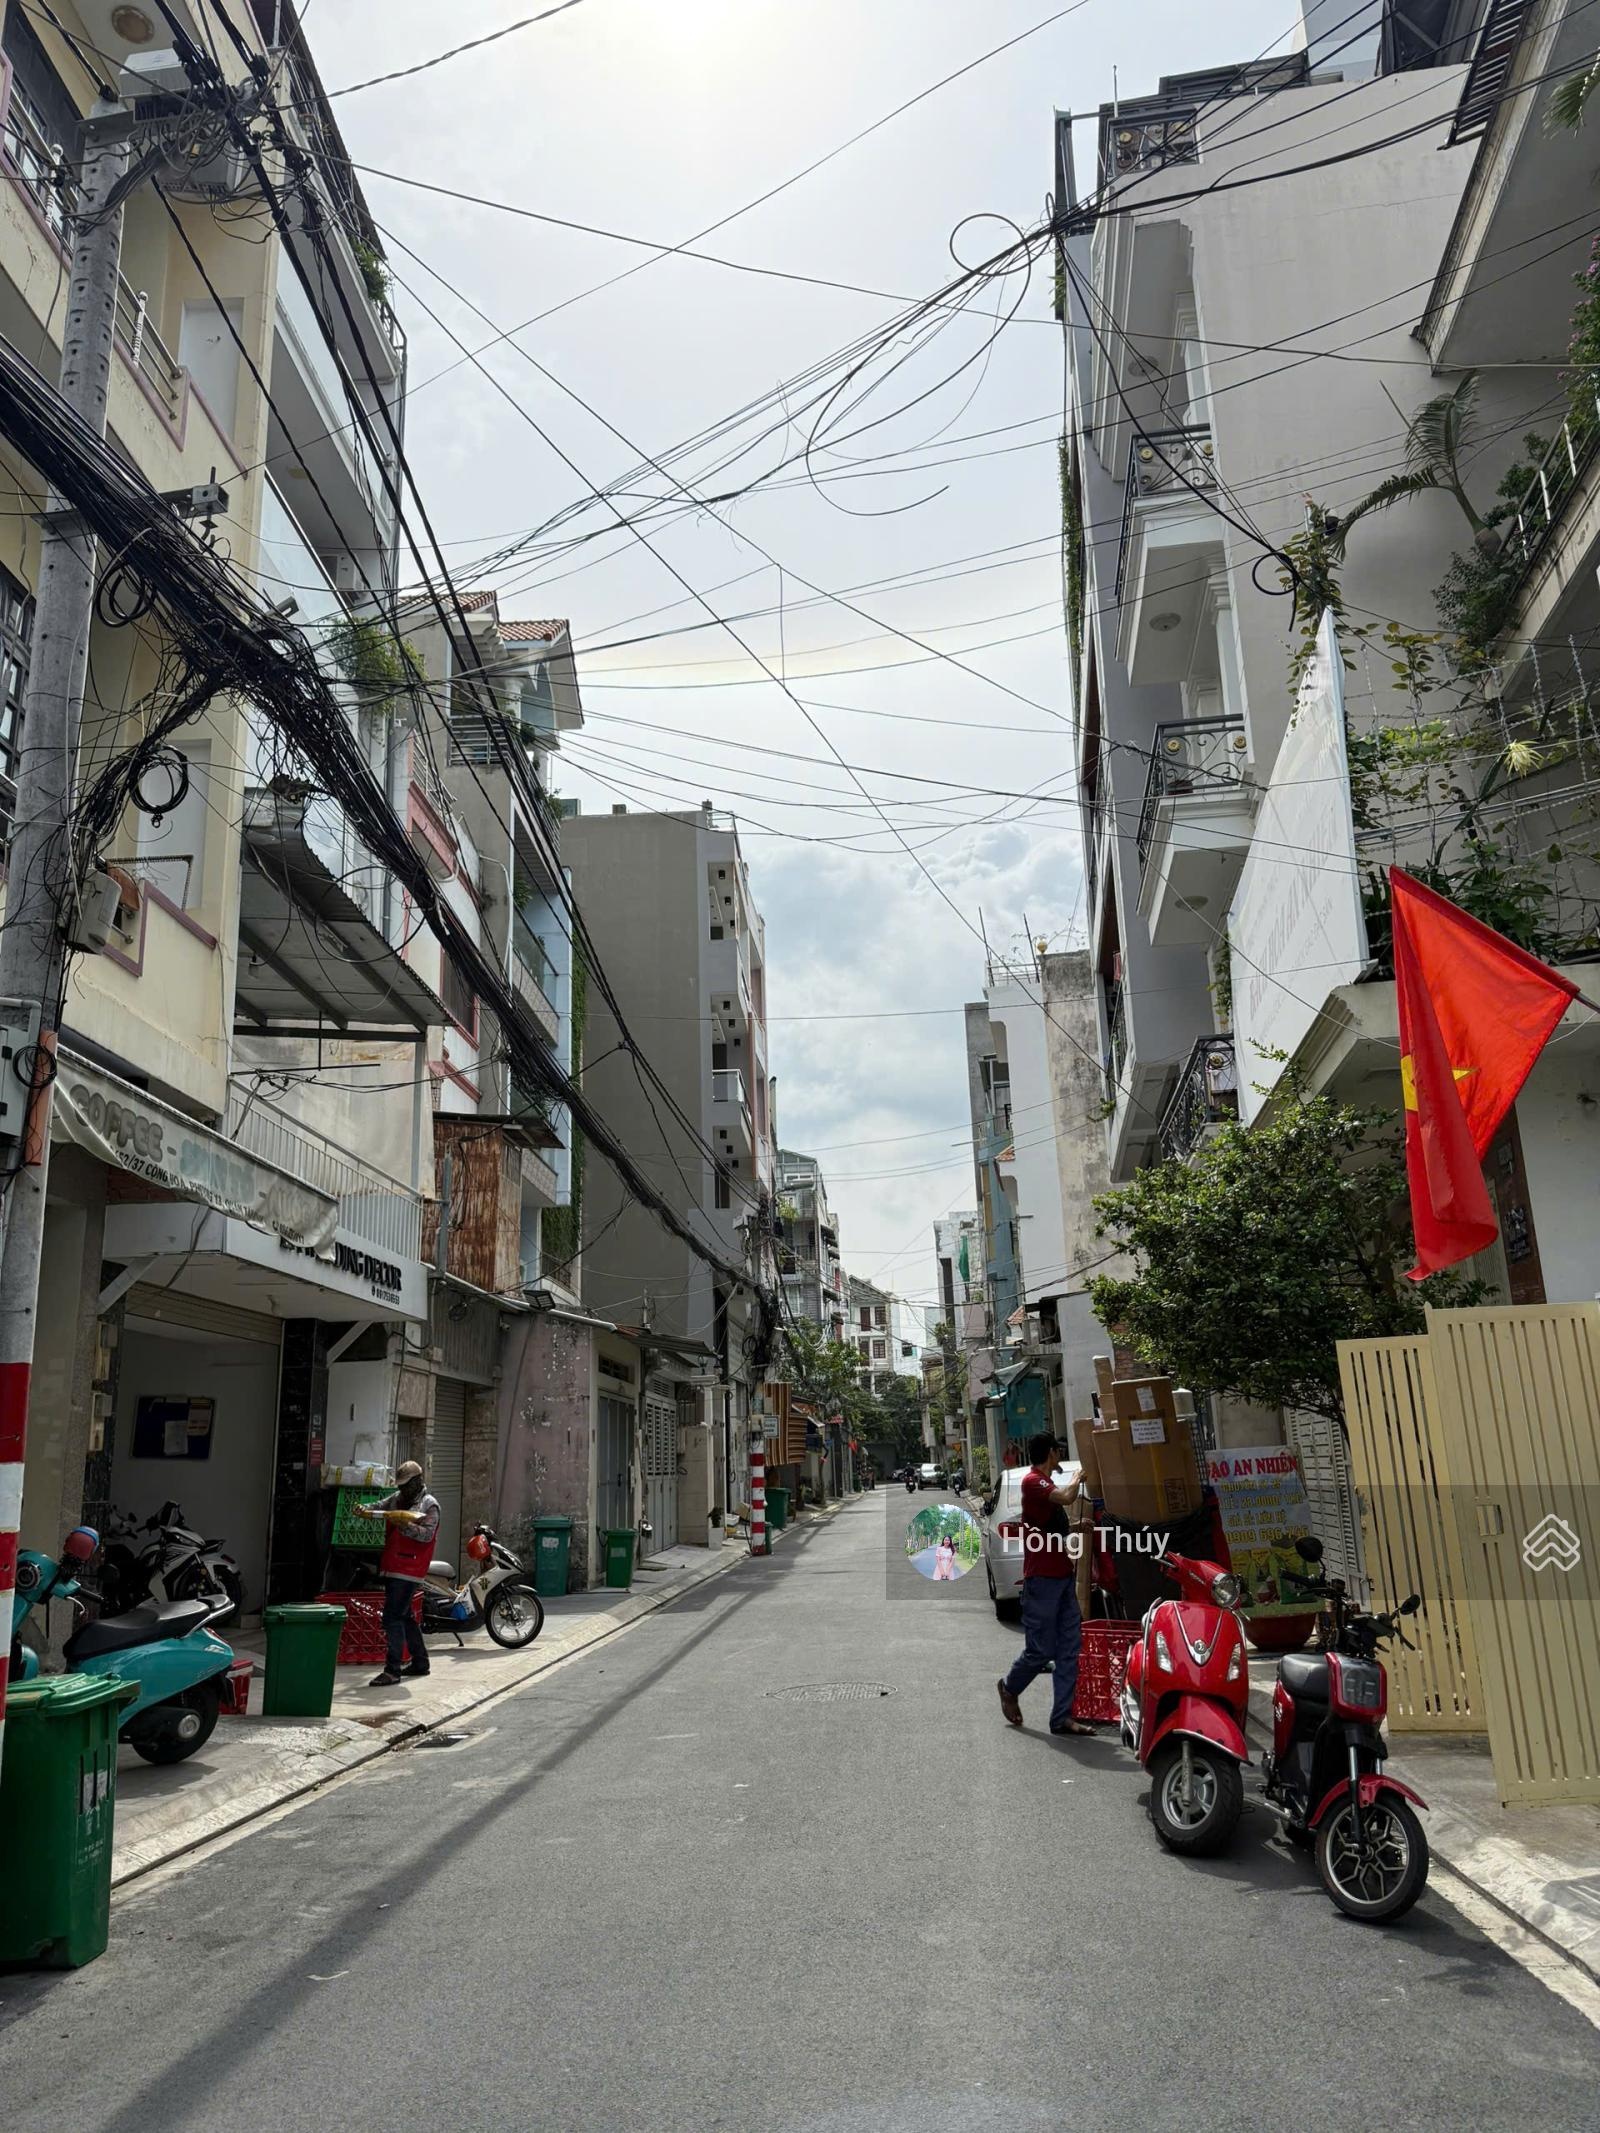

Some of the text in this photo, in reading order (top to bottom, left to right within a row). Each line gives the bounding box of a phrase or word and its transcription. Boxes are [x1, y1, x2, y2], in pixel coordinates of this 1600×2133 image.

[70, 1084, 163, 1163] COFFEE
[364, 1255, 402, 1291] DECOR
[1234, 1458, 1253, 1476] AN
[1255, 1451, 1297, 1474] NHIÊN
